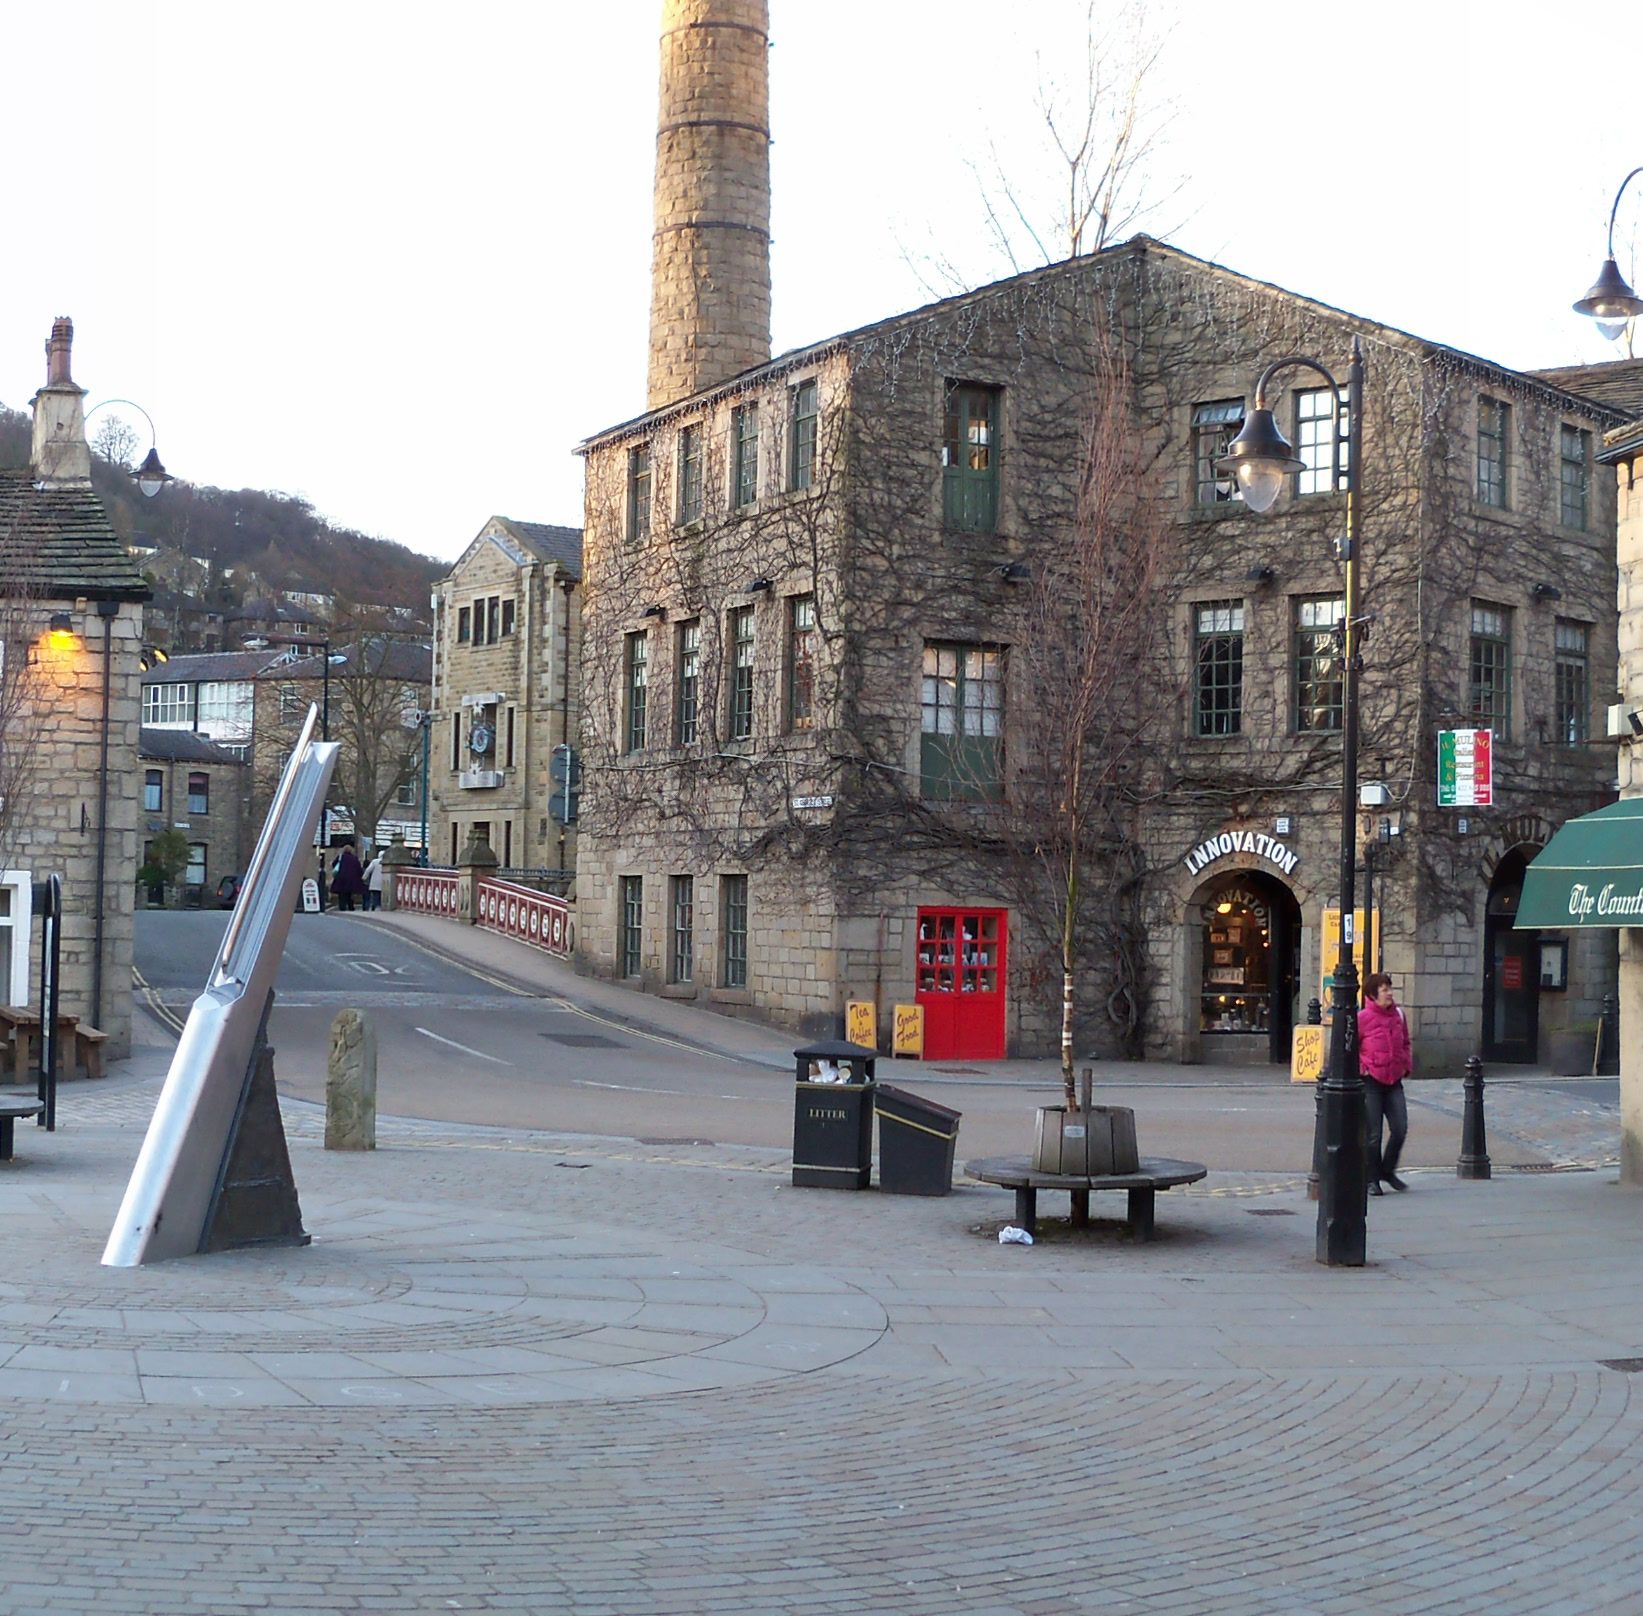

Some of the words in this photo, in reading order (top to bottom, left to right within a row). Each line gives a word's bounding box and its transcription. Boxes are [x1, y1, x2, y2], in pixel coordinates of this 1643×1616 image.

[1184, 831, 1299, 876] INNOVATION
[1568, 883, 1595, 924] The
[849, 1004, 870, 1020] Tea
[897, 1008, 919, 1028] Good
[897, 1026, 919, 1047] Food
[1296, 1031, 1320, 1053] Shop
[809, 1107, 846, 1119] LITTER
